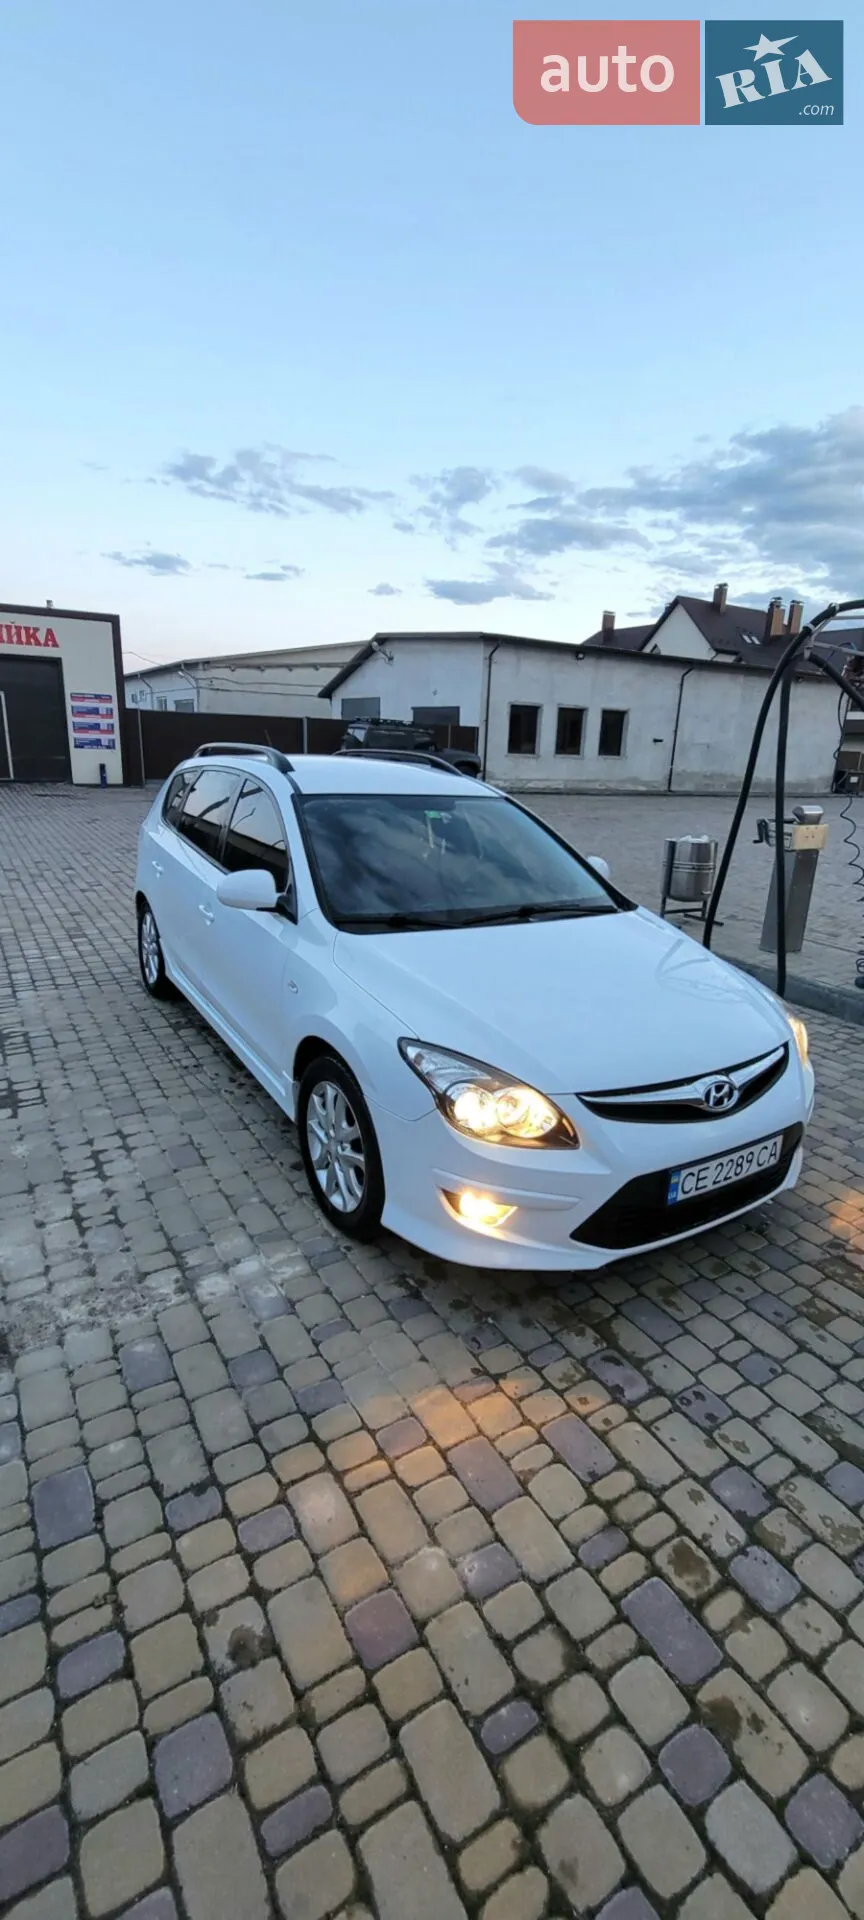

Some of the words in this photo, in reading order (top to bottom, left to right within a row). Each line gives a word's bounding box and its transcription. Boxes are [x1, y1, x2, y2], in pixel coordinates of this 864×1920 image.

[0, 620, 60, 648] ЙКА
[681, 1166, 710, 1195] CE
[712, 1151, 753, 1185] 2289
[756, 1141, 777, 1167] CA
